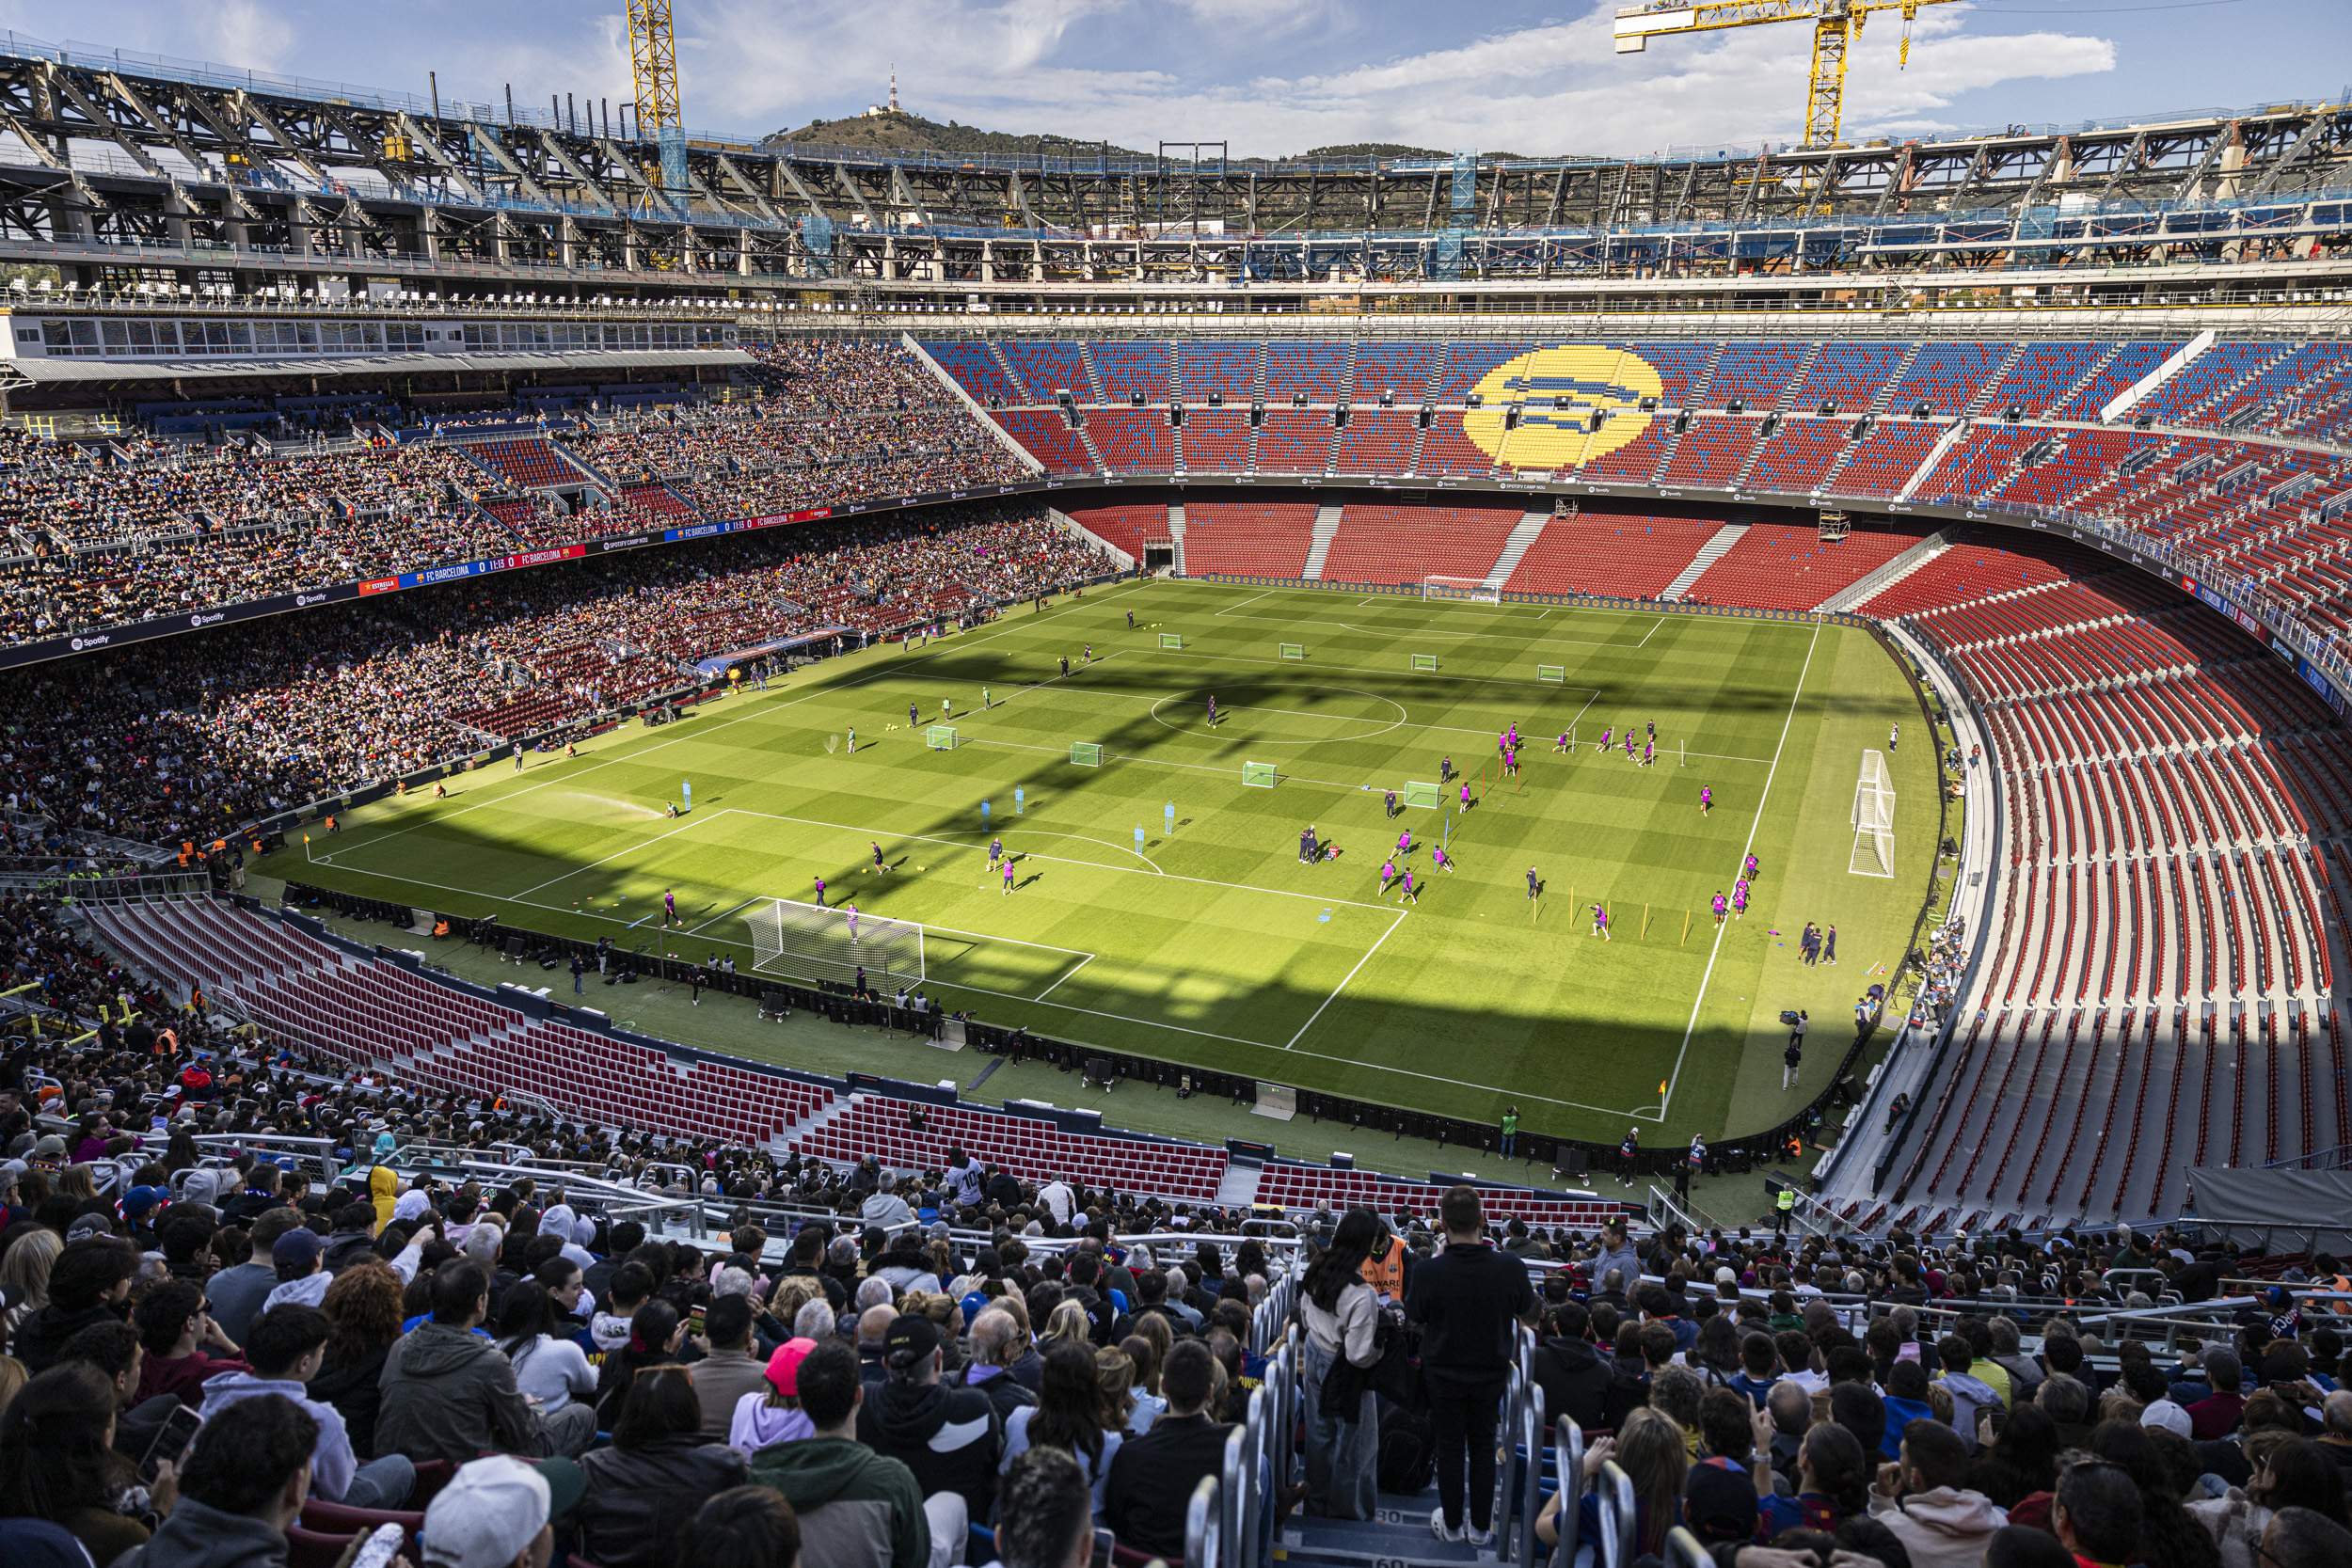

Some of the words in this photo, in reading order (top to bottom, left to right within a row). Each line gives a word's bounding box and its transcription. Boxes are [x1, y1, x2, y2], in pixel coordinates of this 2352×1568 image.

[764, 515, 787, 525] BARCELONA
[691, 525, 718, 536] BARCELONA
[610, 540, 627, 548] SPOTIFY
[627, 538, 639, 546] CAMP
[508, 558, 515, 567] 0
[522, 555, 530, 564] FC
[530, 550, 561, 563] BARCELONA
[479, 562, 485, 573] 0
[489, 560, 505, 571] 11:13
[426, 571, 435, 582] FC
[435, 565, 469, 580] BARCELONA
[372, 580, 394, 590] ESTRELLA
[306, 594, 326, 604] Spotify
[201, 612, 225, 624] Spotify
[84, 635, 110, 647] Spotify
[962, 1170, 977, 1190] 10
